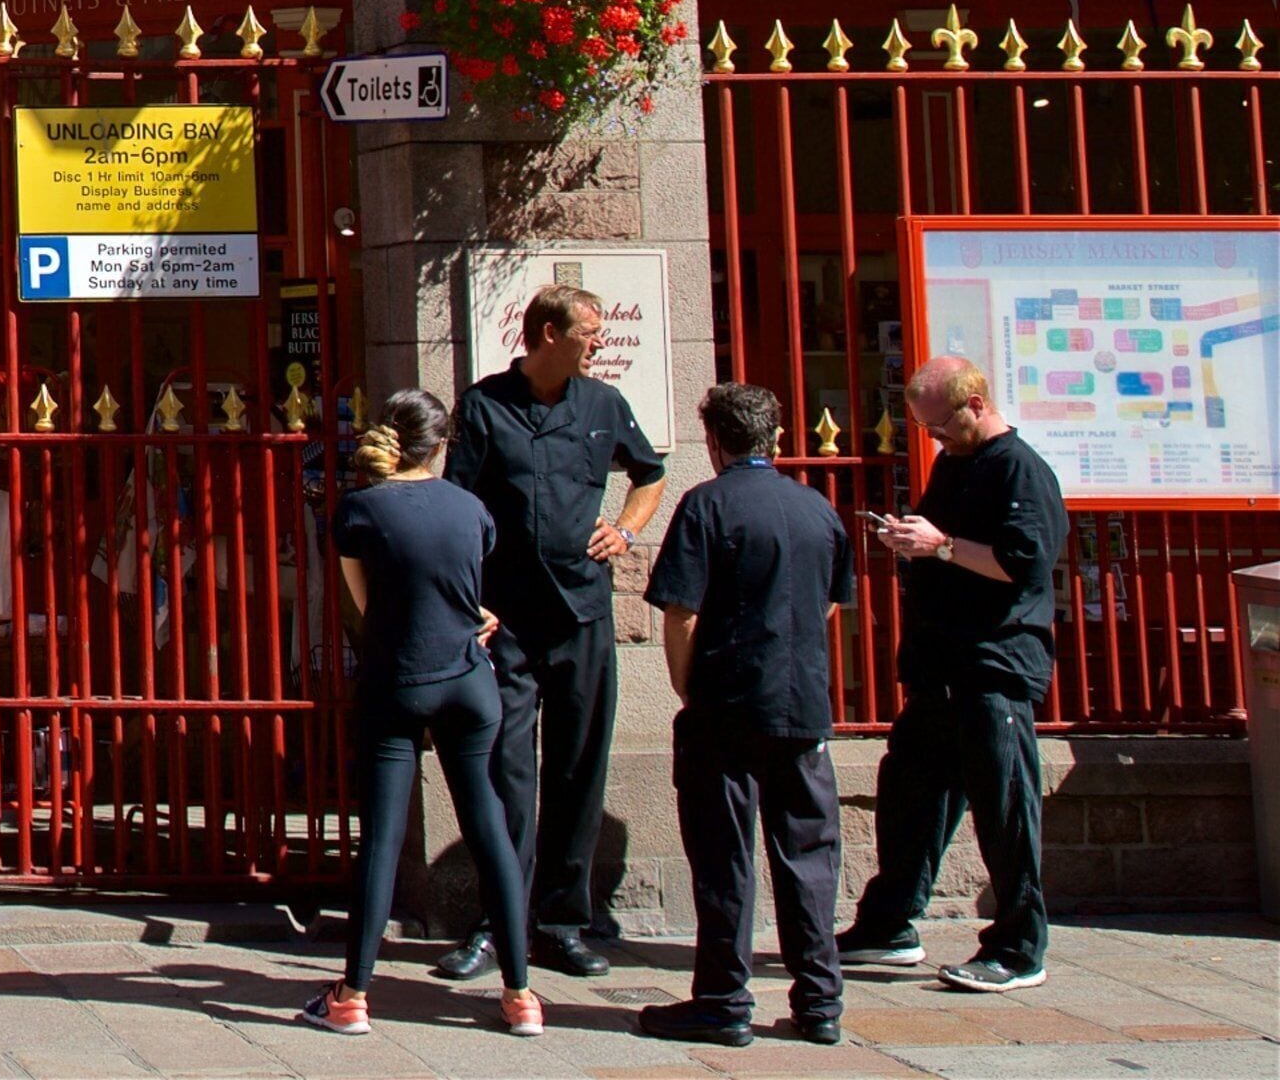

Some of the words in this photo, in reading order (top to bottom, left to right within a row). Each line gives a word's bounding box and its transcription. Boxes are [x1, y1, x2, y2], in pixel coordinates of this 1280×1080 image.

[347, 75, 412, 102] Toilets
[46, 122, 173, 141] UNLOADING
[184, 122, 223, 141] BAY
[84, 147, 188, 167] 2am-6pm
[53, 171, 81, 183] Disc
[87, 171, 93, 182] 1
[98, 171, 112, 182] Hr
[118, 171, 144, 182] limit
[151, 171, 220, 185] 10am-6pm
[81, 185, 128, 199] Display
[134, 185, 192, 197] Business
[76, 201, 111, 211] name
[117, 199, 141, 211] and
[146, 199, 199, 211] address
[97, 243, 153, 258] Parking
[160, 243, 227, 258] permited
[993, 242, 1080, 264] JERSEY
[1088, 242, 1200, 261] MARKETS
[29, 247, 61, 289] P
[91, 260, 122, 272] Mon
[129, 260, 155, 272] Sat
[161, 260, 235, 275] 6pm-2am
[88, 276, 144, 291] Sunday
[151, 278, 165, 288] at
[172, 279, 199, 291] any
[206, 276, 238, 288] time
[292, 326, 320, 339] BLAC
